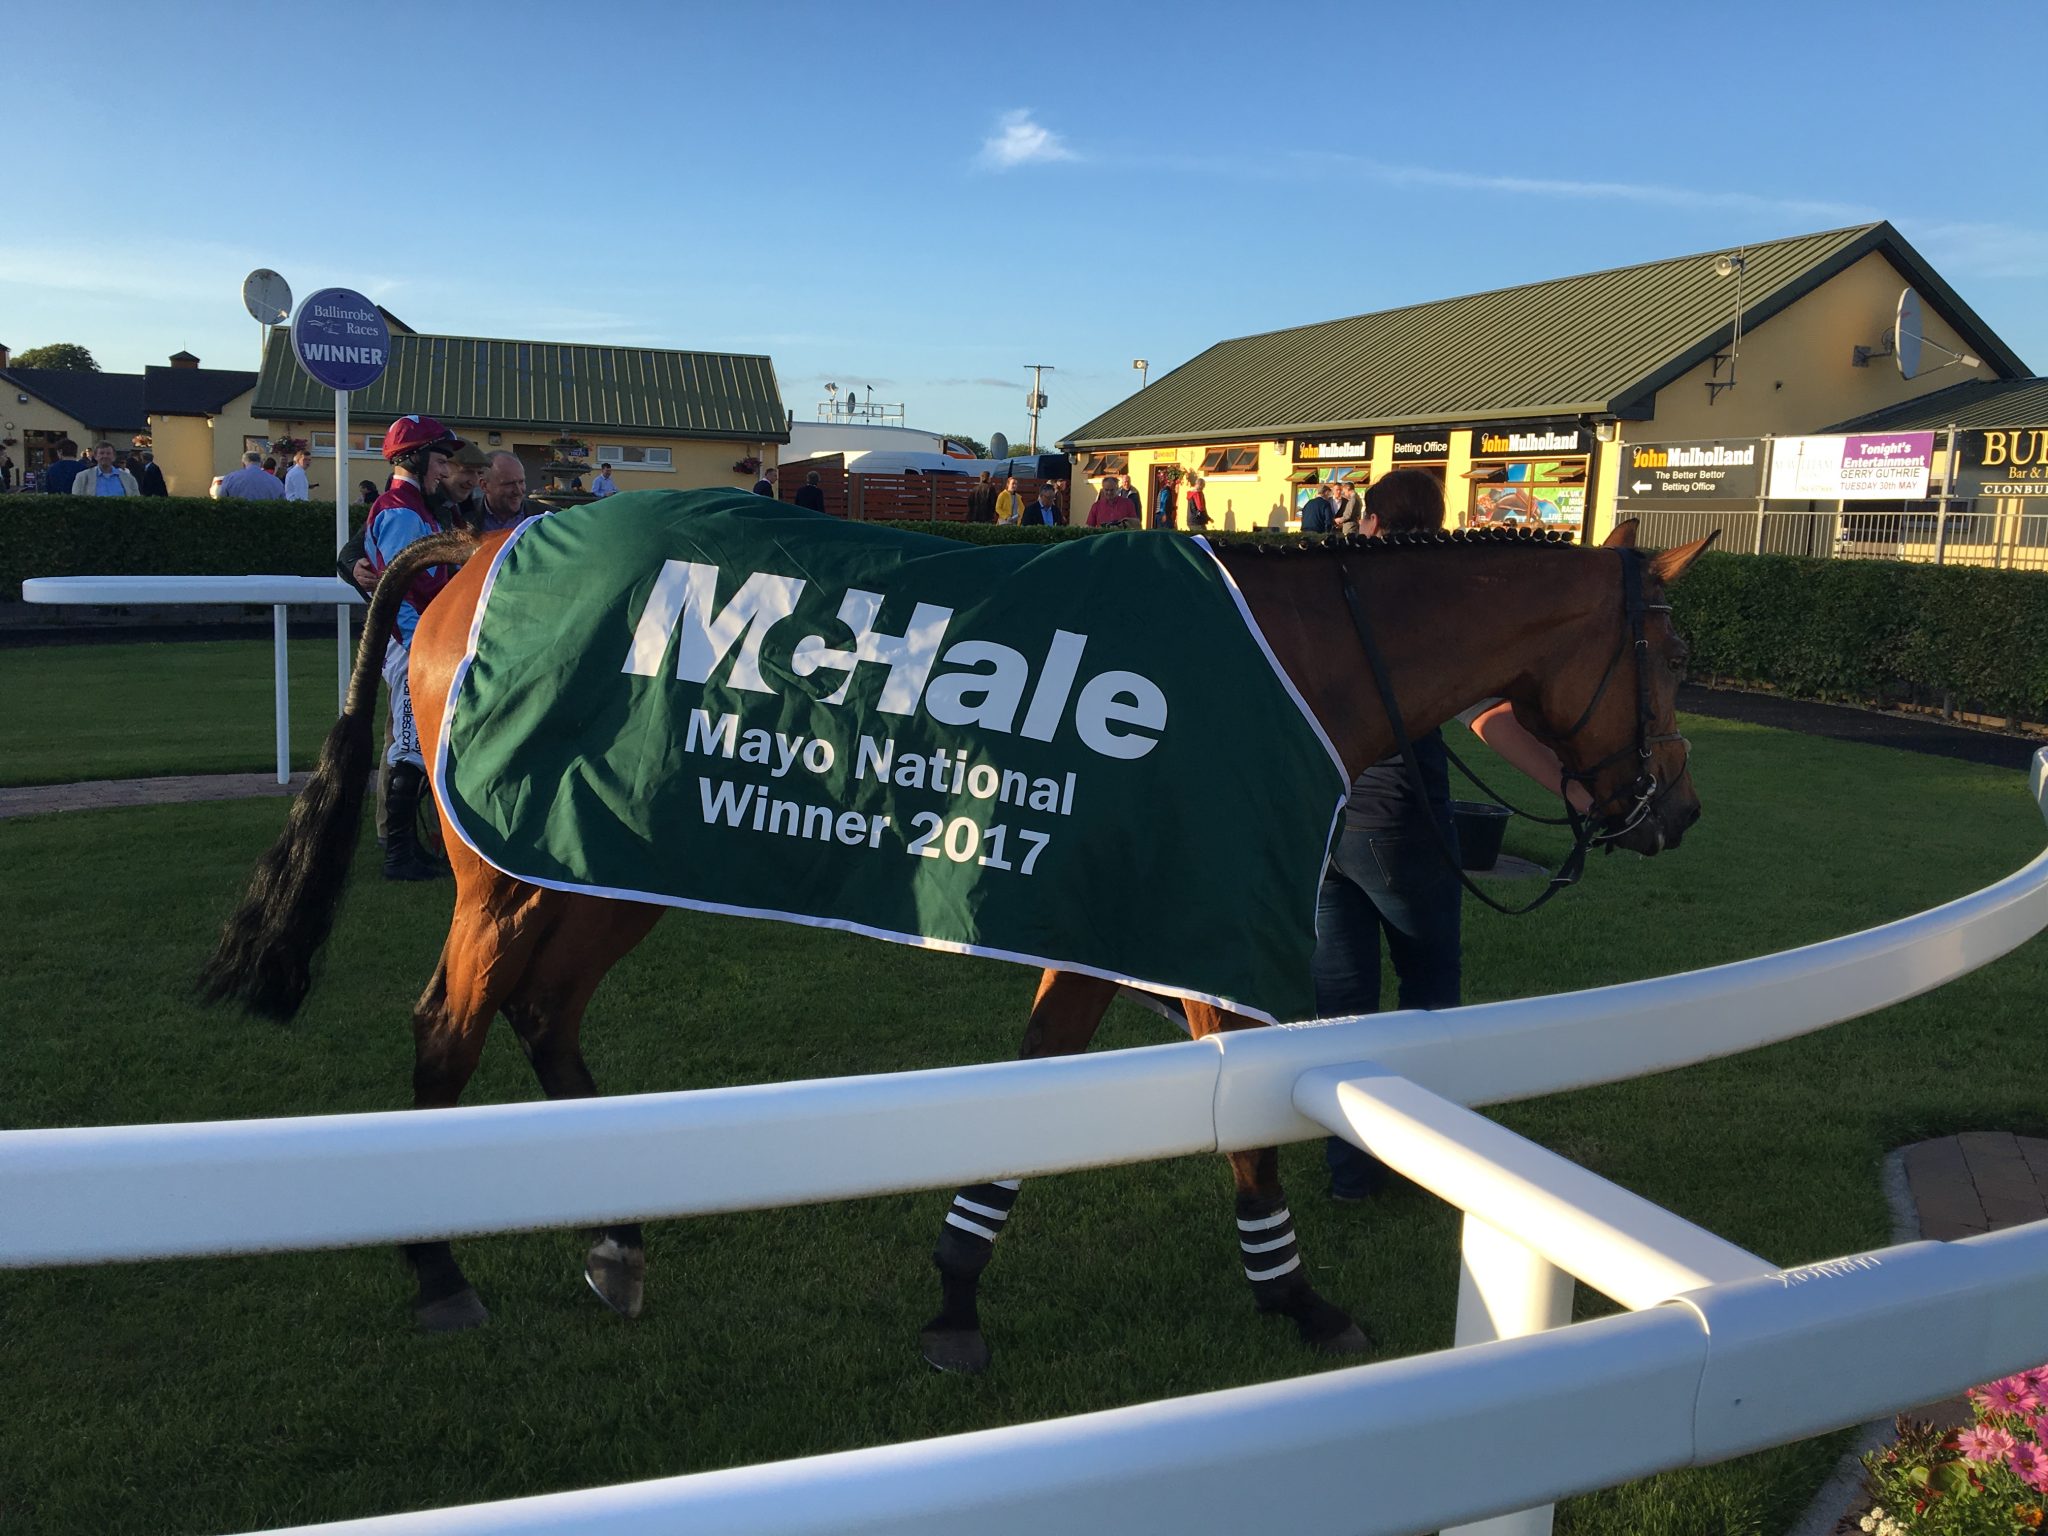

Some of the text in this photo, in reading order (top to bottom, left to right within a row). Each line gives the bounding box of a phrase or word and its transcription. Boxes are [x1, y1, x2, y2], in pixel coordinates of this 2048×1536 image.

[314, 305, 374, 322] Ballinrobe
[346, 322, 379, 336] Races
[303, 343, 383, 365] WINNER
[1394, 441, 1448, 455] Betting Office
[1860, 442, 1911, 456] Tonight's
[1843, 455, 1925, 467] Entertainment
[1656, 470, 1725, 479] The Better Bettor
[1840, 468, 1920, 479] GERRY GUTHRIE
[2008, 466, 2027, 478] Bar
[2029, 466, 2041, 478] &
[1662, 482, 1715, 492] Betting Office
[1840, 482, 1878, 490] TUESDAY
[1879, 481, 1896, 490] 30th
[1898, 481, 1917, 489] MAY
[1984, 485, 2048, 494] CLONBU
[621, 559, 1168, 760] McHale
[684, 707, 1077, 816] Mayo National
[698, 776, 1051, 875] Winner 2017
